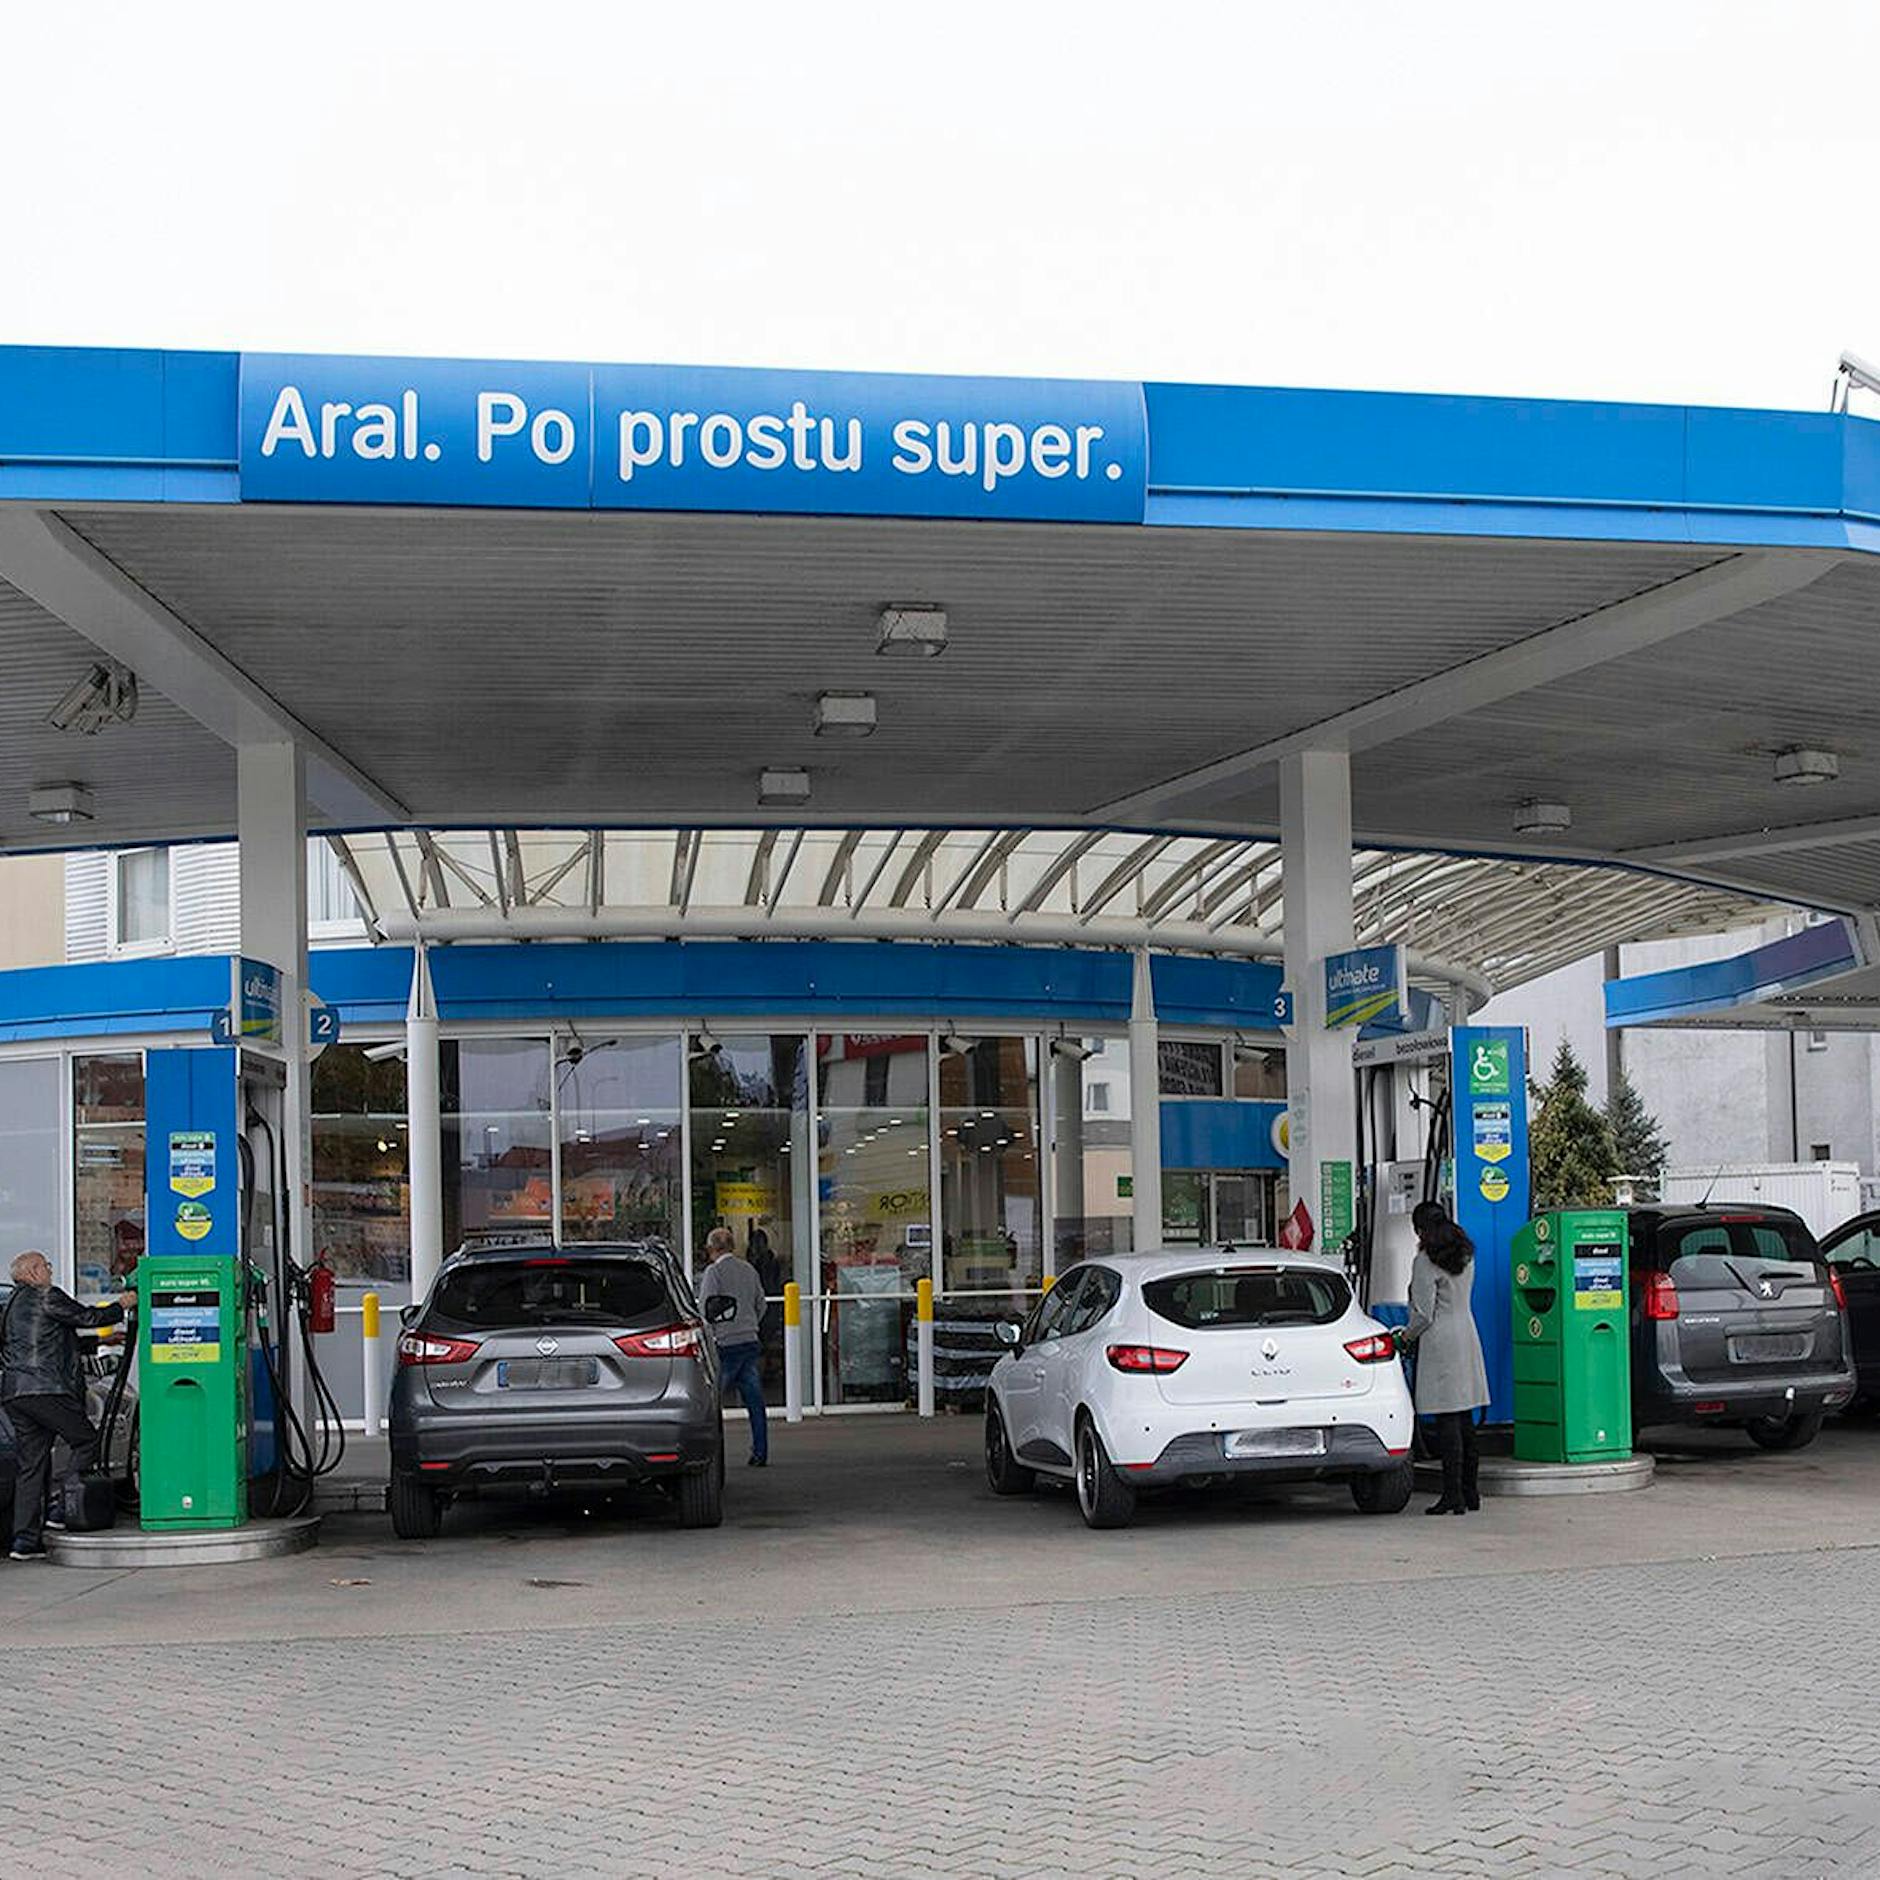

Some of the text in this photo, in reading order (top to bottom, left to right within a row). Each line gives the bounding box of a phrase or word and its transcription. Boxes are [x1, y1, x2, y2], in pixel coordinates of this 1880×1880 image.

[260, 385, 1124, 492] Aral. Po prostu super.
[1274, 997, 1286, 1018] 3
[219, 1016, 231, 1036] 1
[317, 1014, 333, 1035] 2
